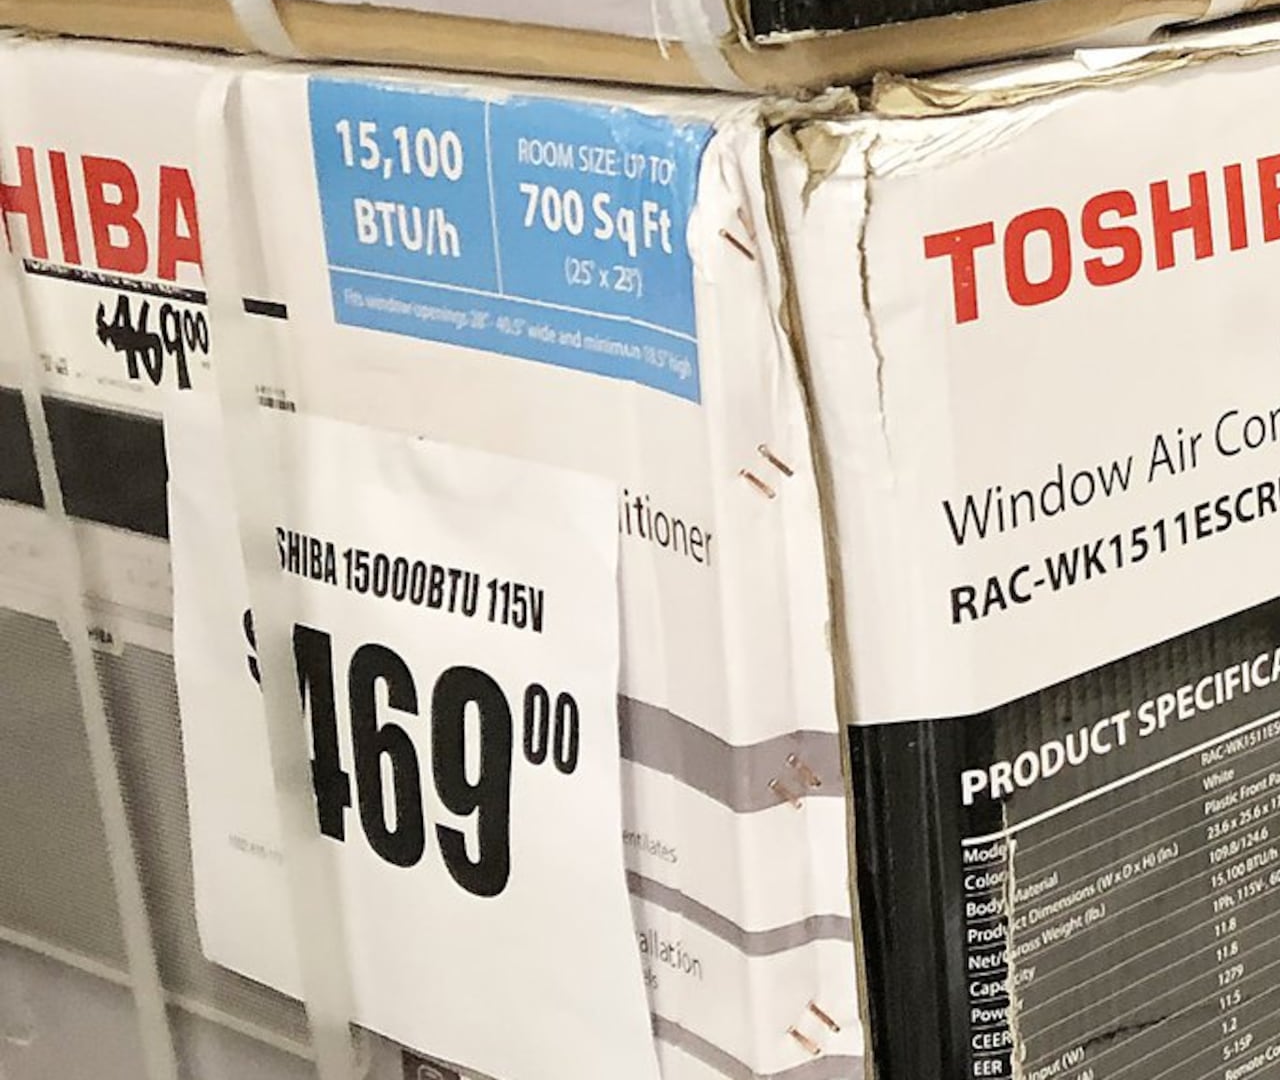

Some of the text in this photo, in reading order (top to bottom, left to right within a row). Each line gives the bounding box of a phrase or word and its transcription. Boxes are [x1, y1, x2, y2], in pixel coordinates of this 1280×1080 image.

[336, 119, 463, 183] 15,100
[518, 138, 574, 171] ROOM
[624, 153, 645, 181] UP
[648, 155, 675, 187] TO
[0, 145, 202, 280] HIBA
[355, 197, 461, 259] BTU/h
[520, 183, 674, 259] 700 Sq Ft
[941, 451, 1134, 546] Window
[1148, 428, 1202, 482] Air
[276, 526, 545, 633] SHIBA 15000BTU 115V
[293, 622, 580, 898] 469 00
[961, 711, 1131, 806] PRODUCT
[1203, 767, 1234, 791] White
[1208, 826, 1269, 864] 109.8/124.6
[1211, 847, 1278, 889] 15,100 BTU/h
